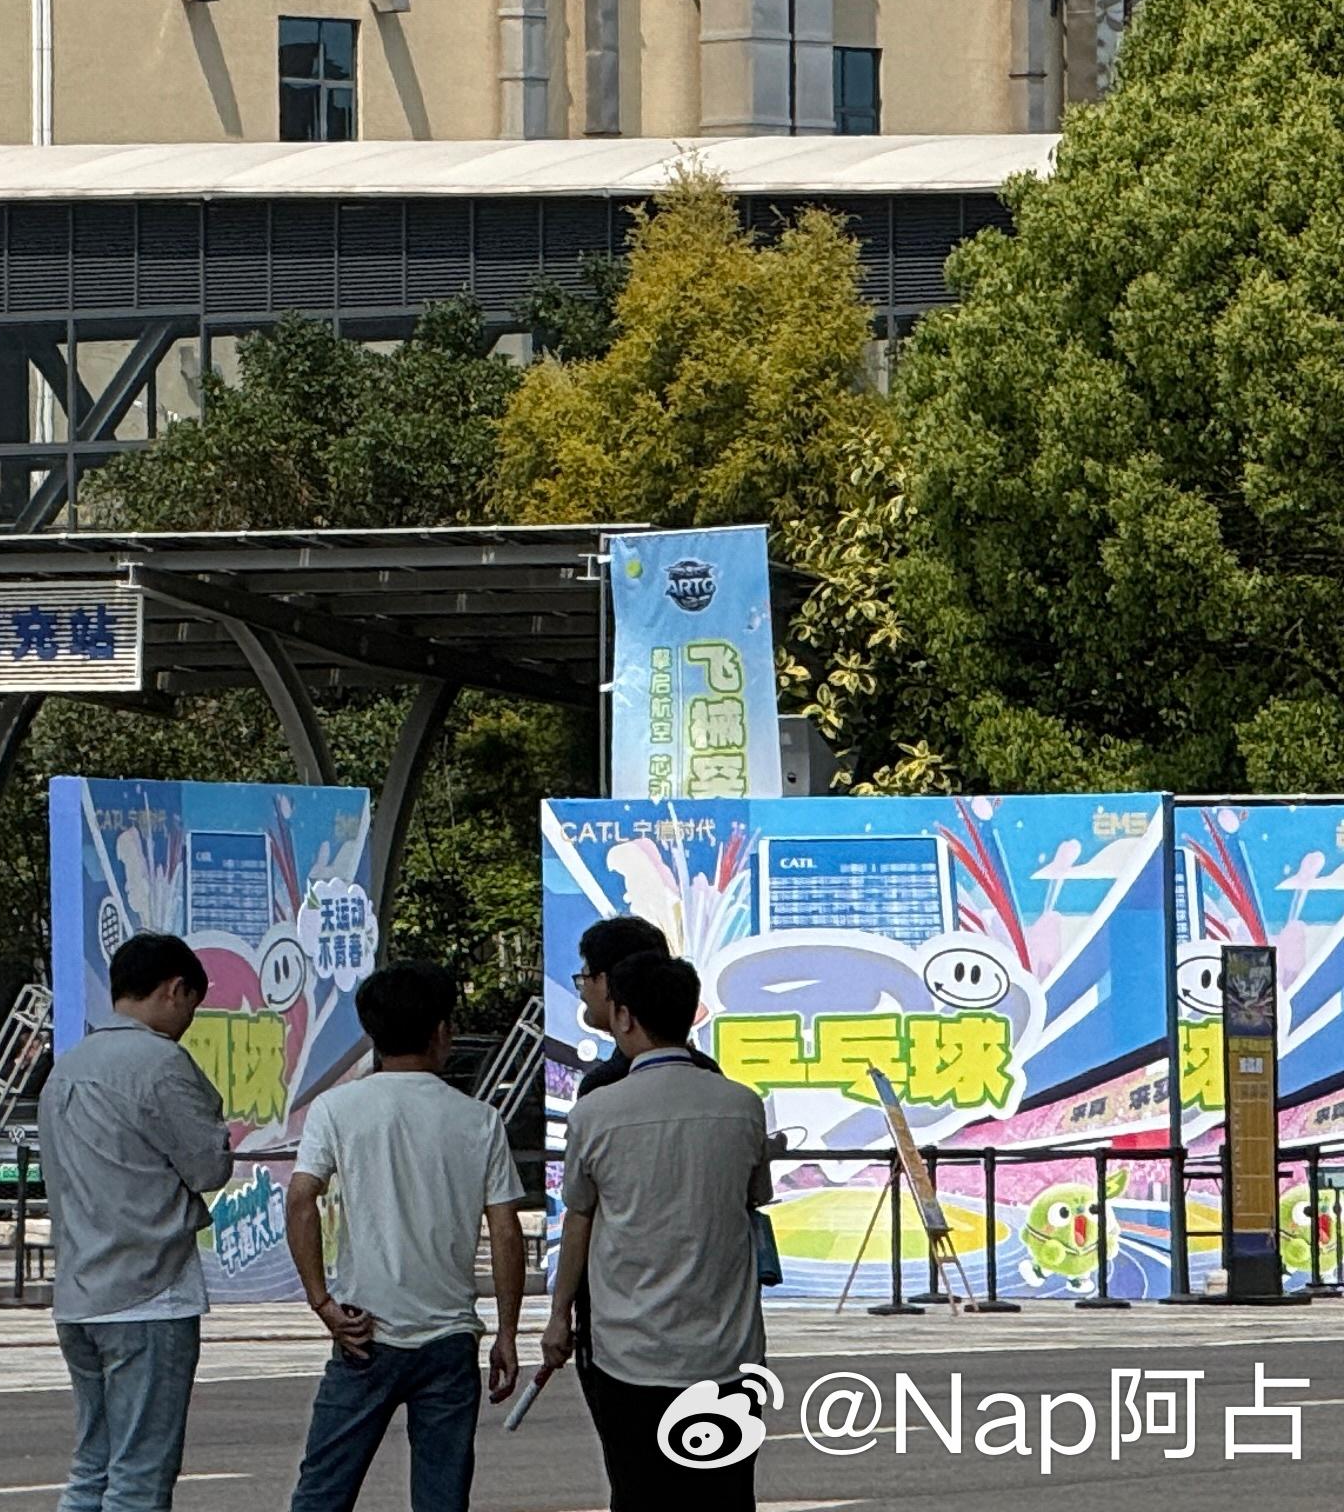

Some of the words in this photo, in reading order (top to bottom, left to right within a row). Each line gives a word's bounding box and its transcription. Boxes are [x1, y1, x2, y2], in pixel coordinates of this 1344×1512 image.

[561, 821, 629, 843] CATL
[779, 857, 817, 869] CATL
[713, 1012, 1014, 1108] 乒乓球
